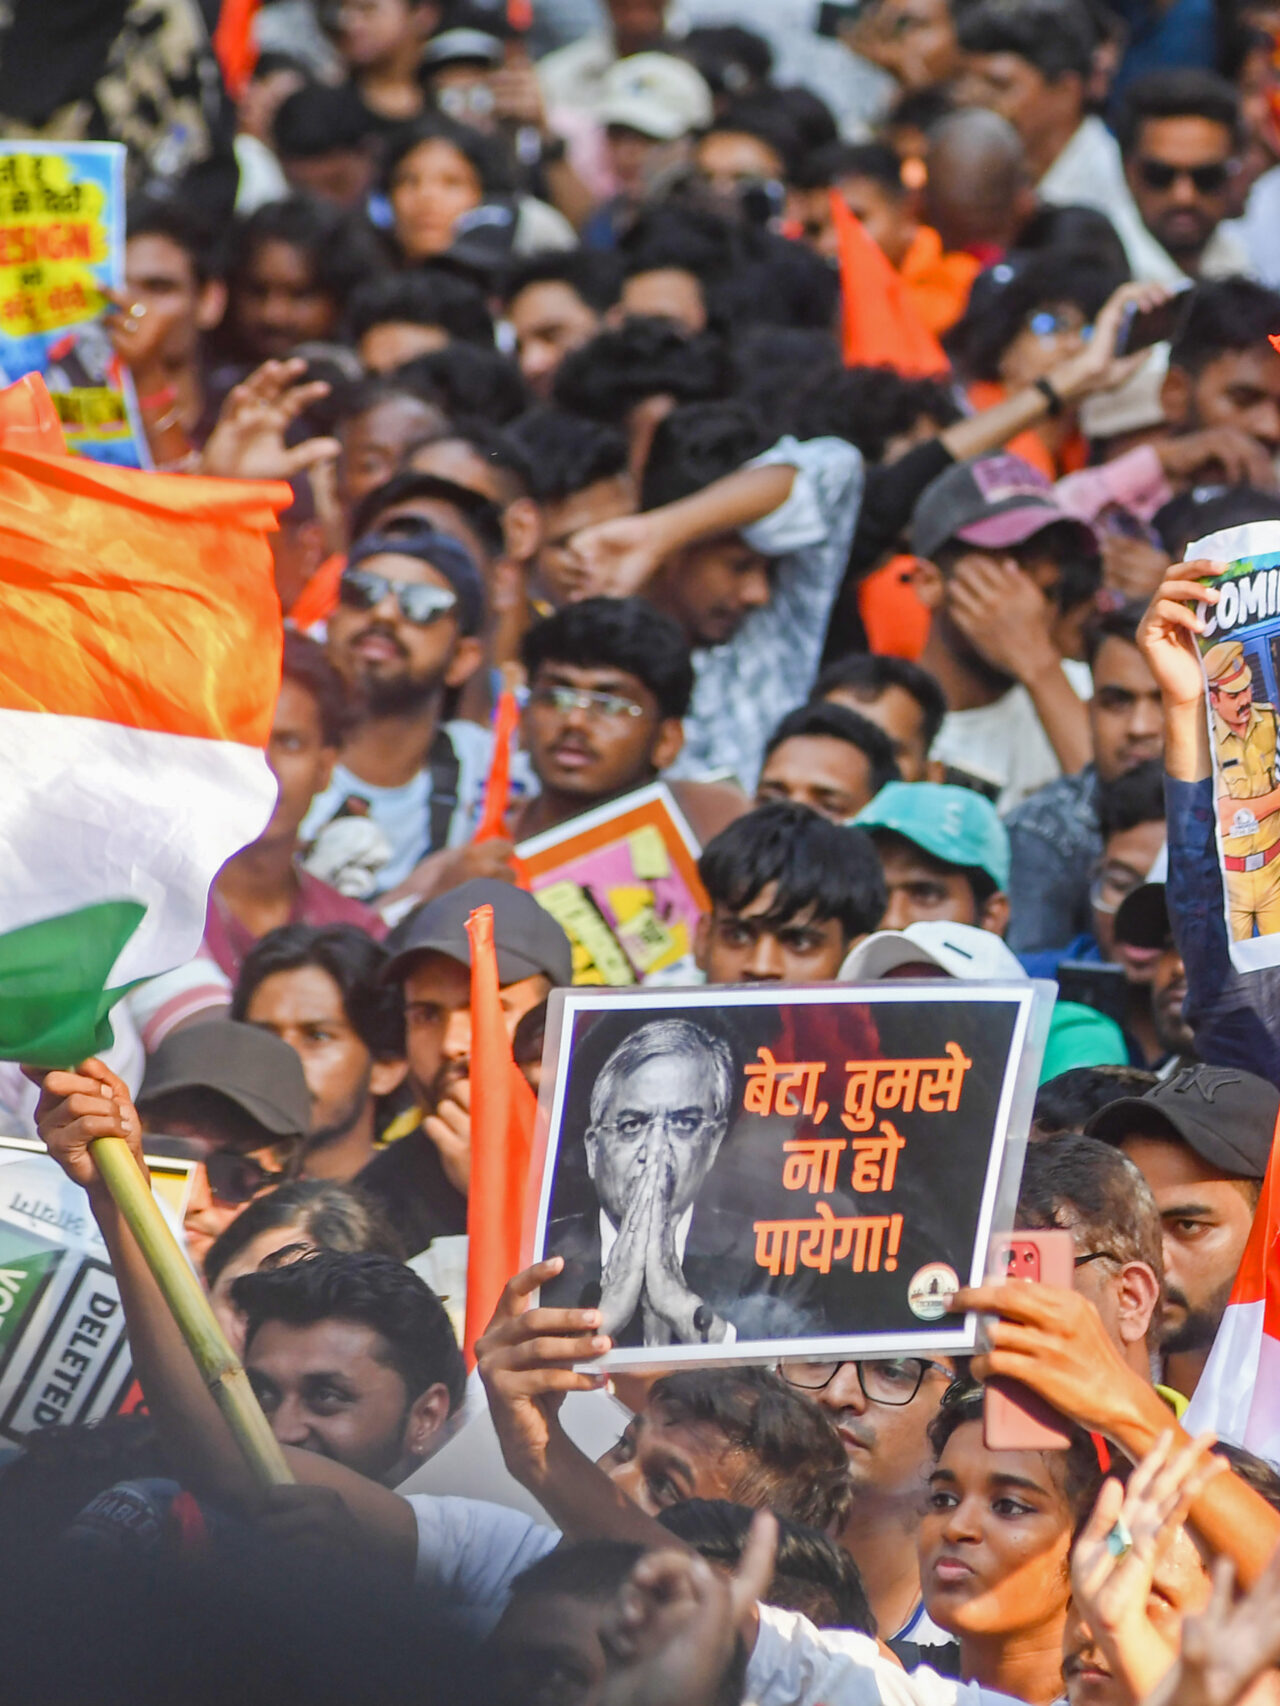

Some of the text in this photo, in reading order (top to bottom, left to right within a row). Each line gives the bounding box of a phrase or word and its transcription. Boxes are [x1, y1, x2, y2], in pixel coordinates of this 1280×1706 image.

[744, 1041, 972, 1132] बेटा, तुमसे
[782, 1120, 906, 1194] ना हो
[753, 1201, 904, 1276] पायेगा!
[33, 1292, 118, 1427] DELETED
